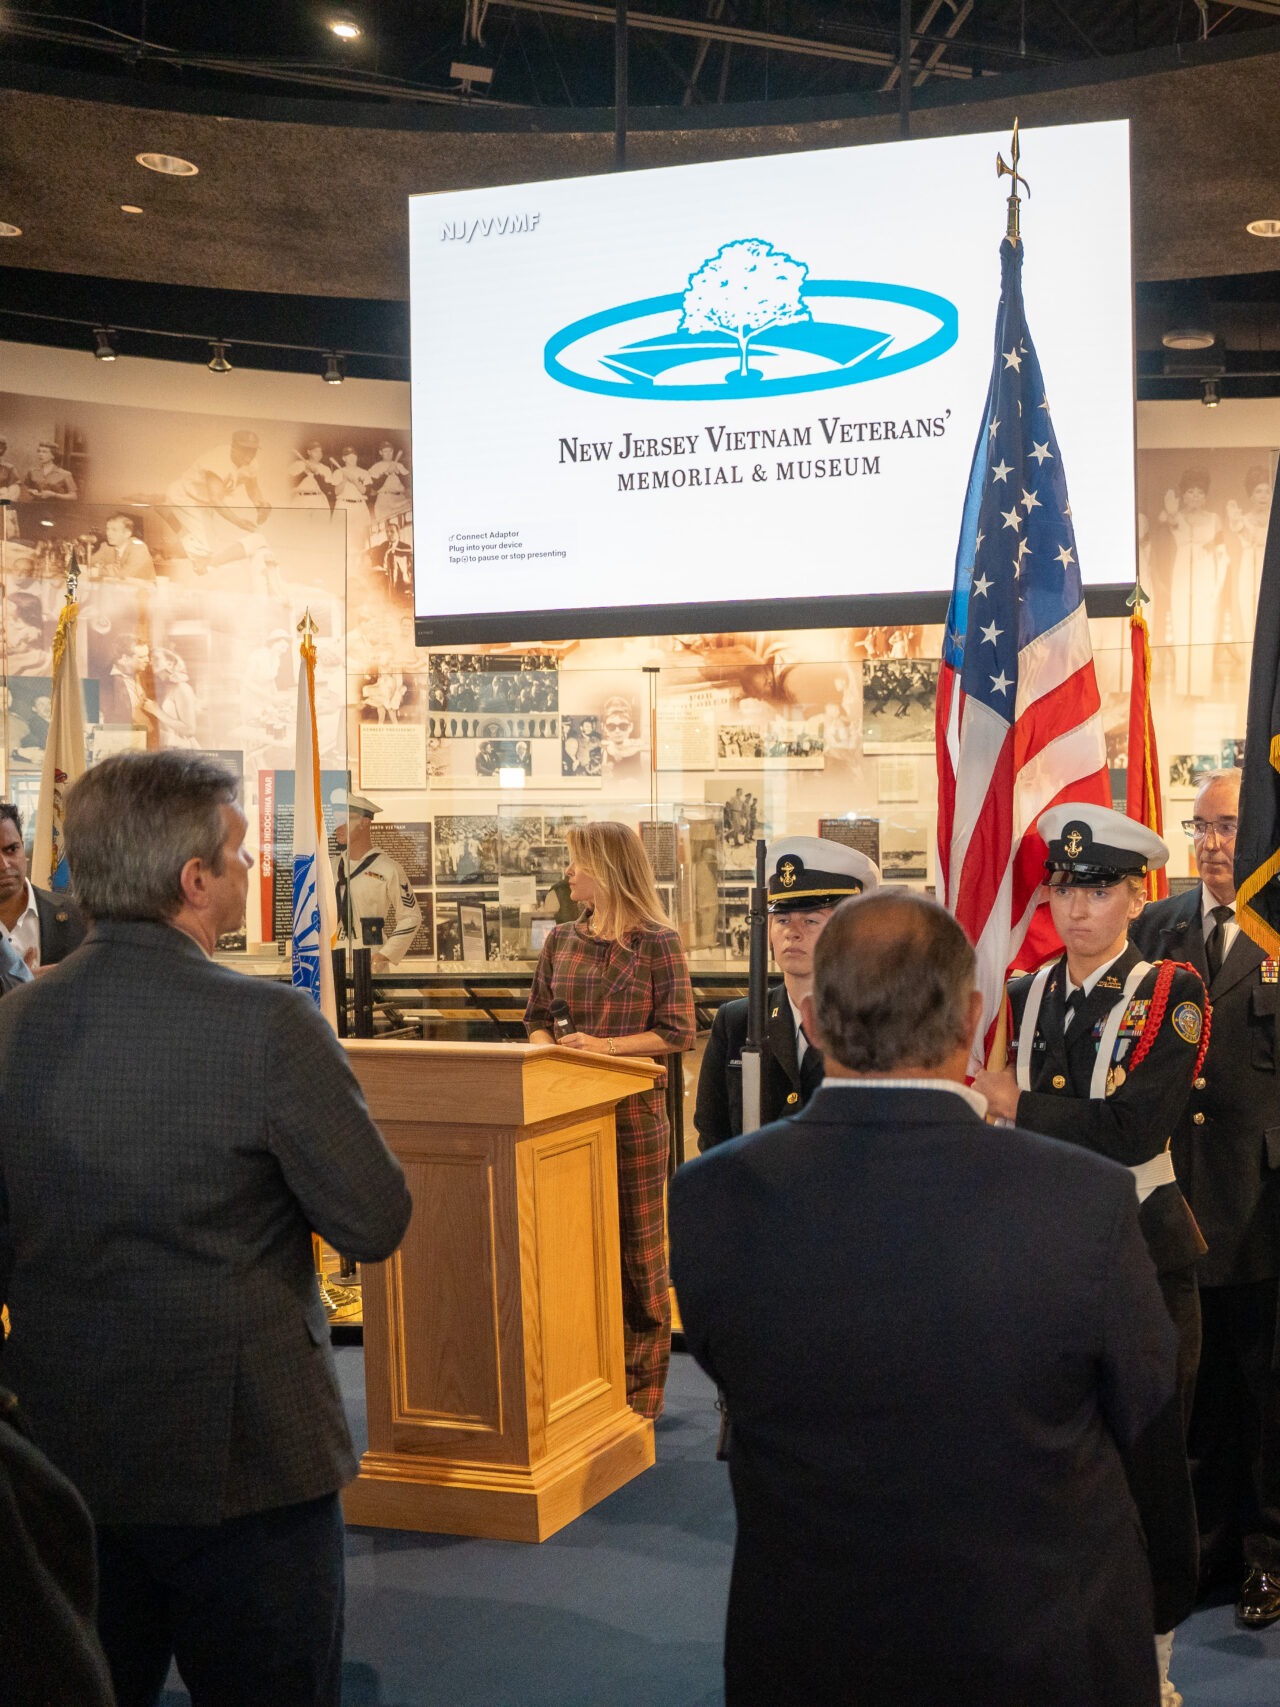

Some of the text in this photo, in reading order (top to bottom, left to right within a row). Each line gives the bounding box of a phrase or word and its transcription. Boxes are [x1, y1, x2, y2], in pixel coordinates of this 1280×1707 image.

[439, 211, 541, 244] NJ/VVMF
[558, 437, 613, 464] NEW
[618, 432, 700, 460] JERSEY
[704, 425, 812, 453] VIETNAM
[616, 455, 882, 492] MEMORIAL & MUSEUM
[448, 545, 465, 553] Plug
[481, 543, 497, 551] your
[498, 541, 523, 550] device
[455, 531, 519, 541] Connect Adaptor
[449, 556, 461, 564] Tap
[477, 554, 500, 563] pause
[509, 552, 526, 561] stop
[527, 549, 567, 560] presenting
[263, 776, 273, 878] SECOND INDOCHINA WAR
